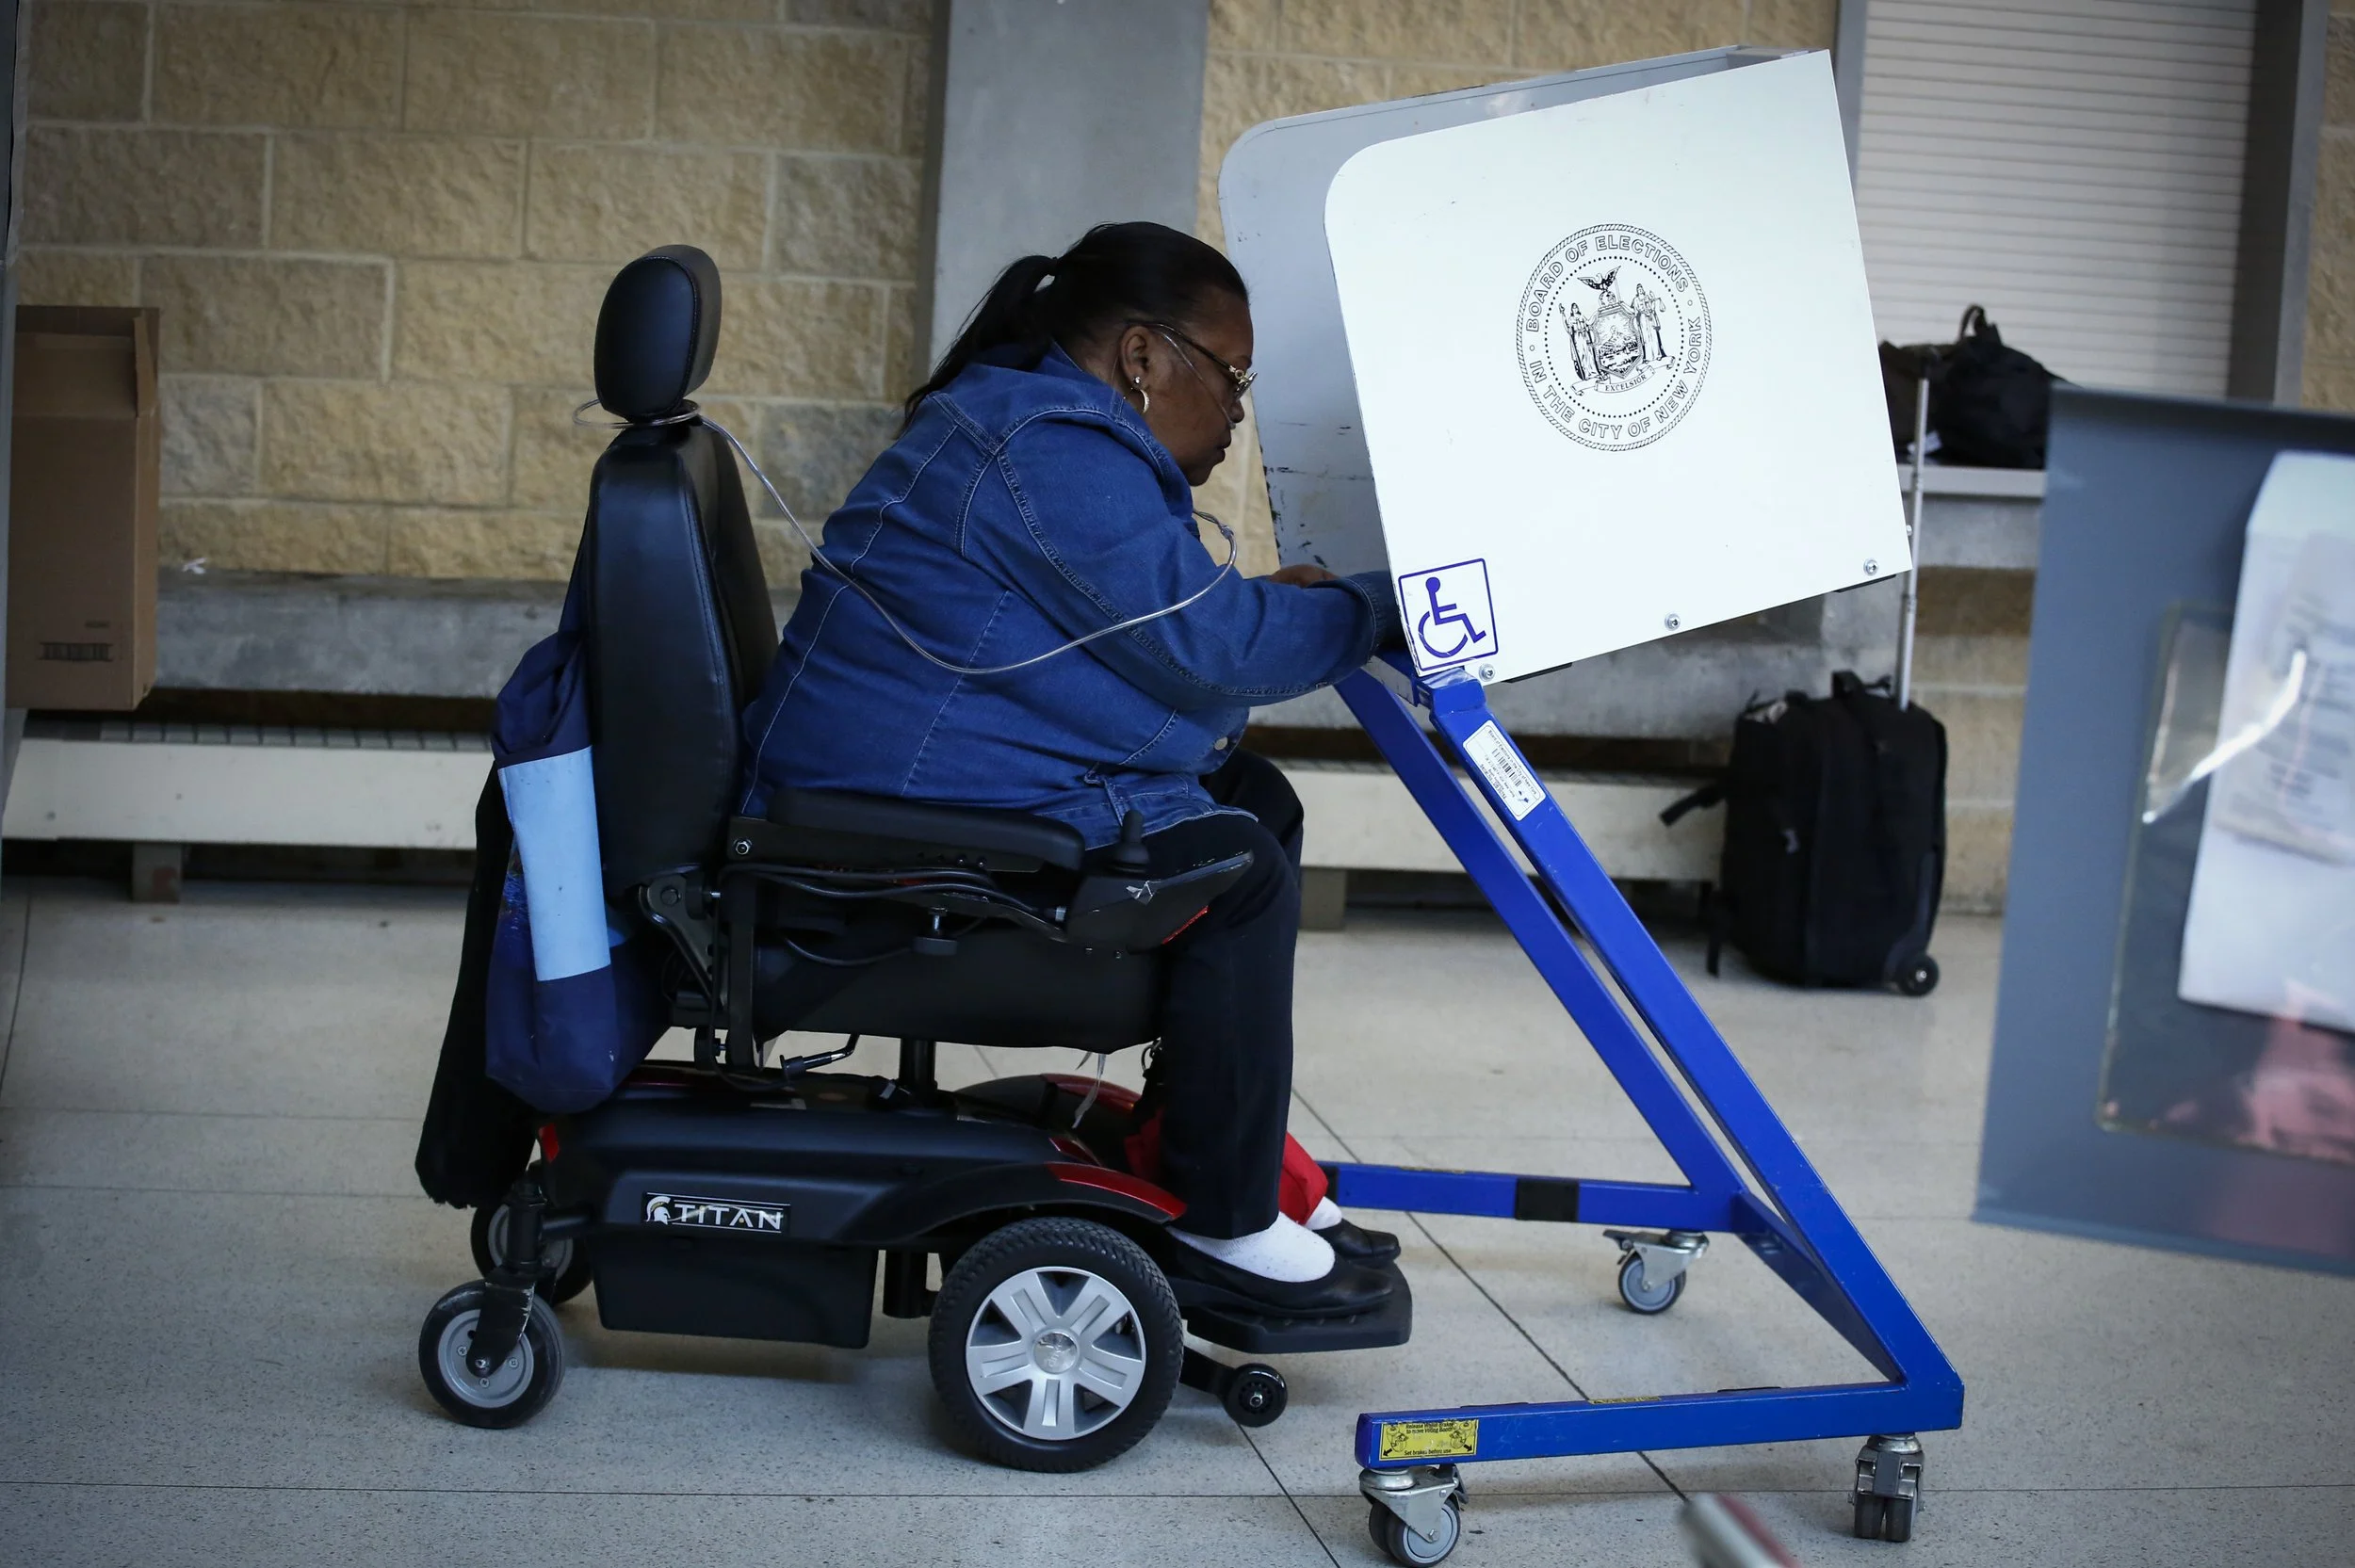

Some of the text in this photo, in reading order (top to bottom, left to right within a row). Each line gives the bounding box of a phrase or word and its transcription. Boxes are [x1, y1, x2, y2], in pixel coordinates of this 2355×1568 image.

[1526, 234, 1689, 332] BOARD OF ELECTIONS
[1530, 316, 1702, 439] IN THE CITY OF NEW YORK
[1605, 375, 1647, 392] EXCELSIOR
[674, 1204, 782, 1230] TITAN
